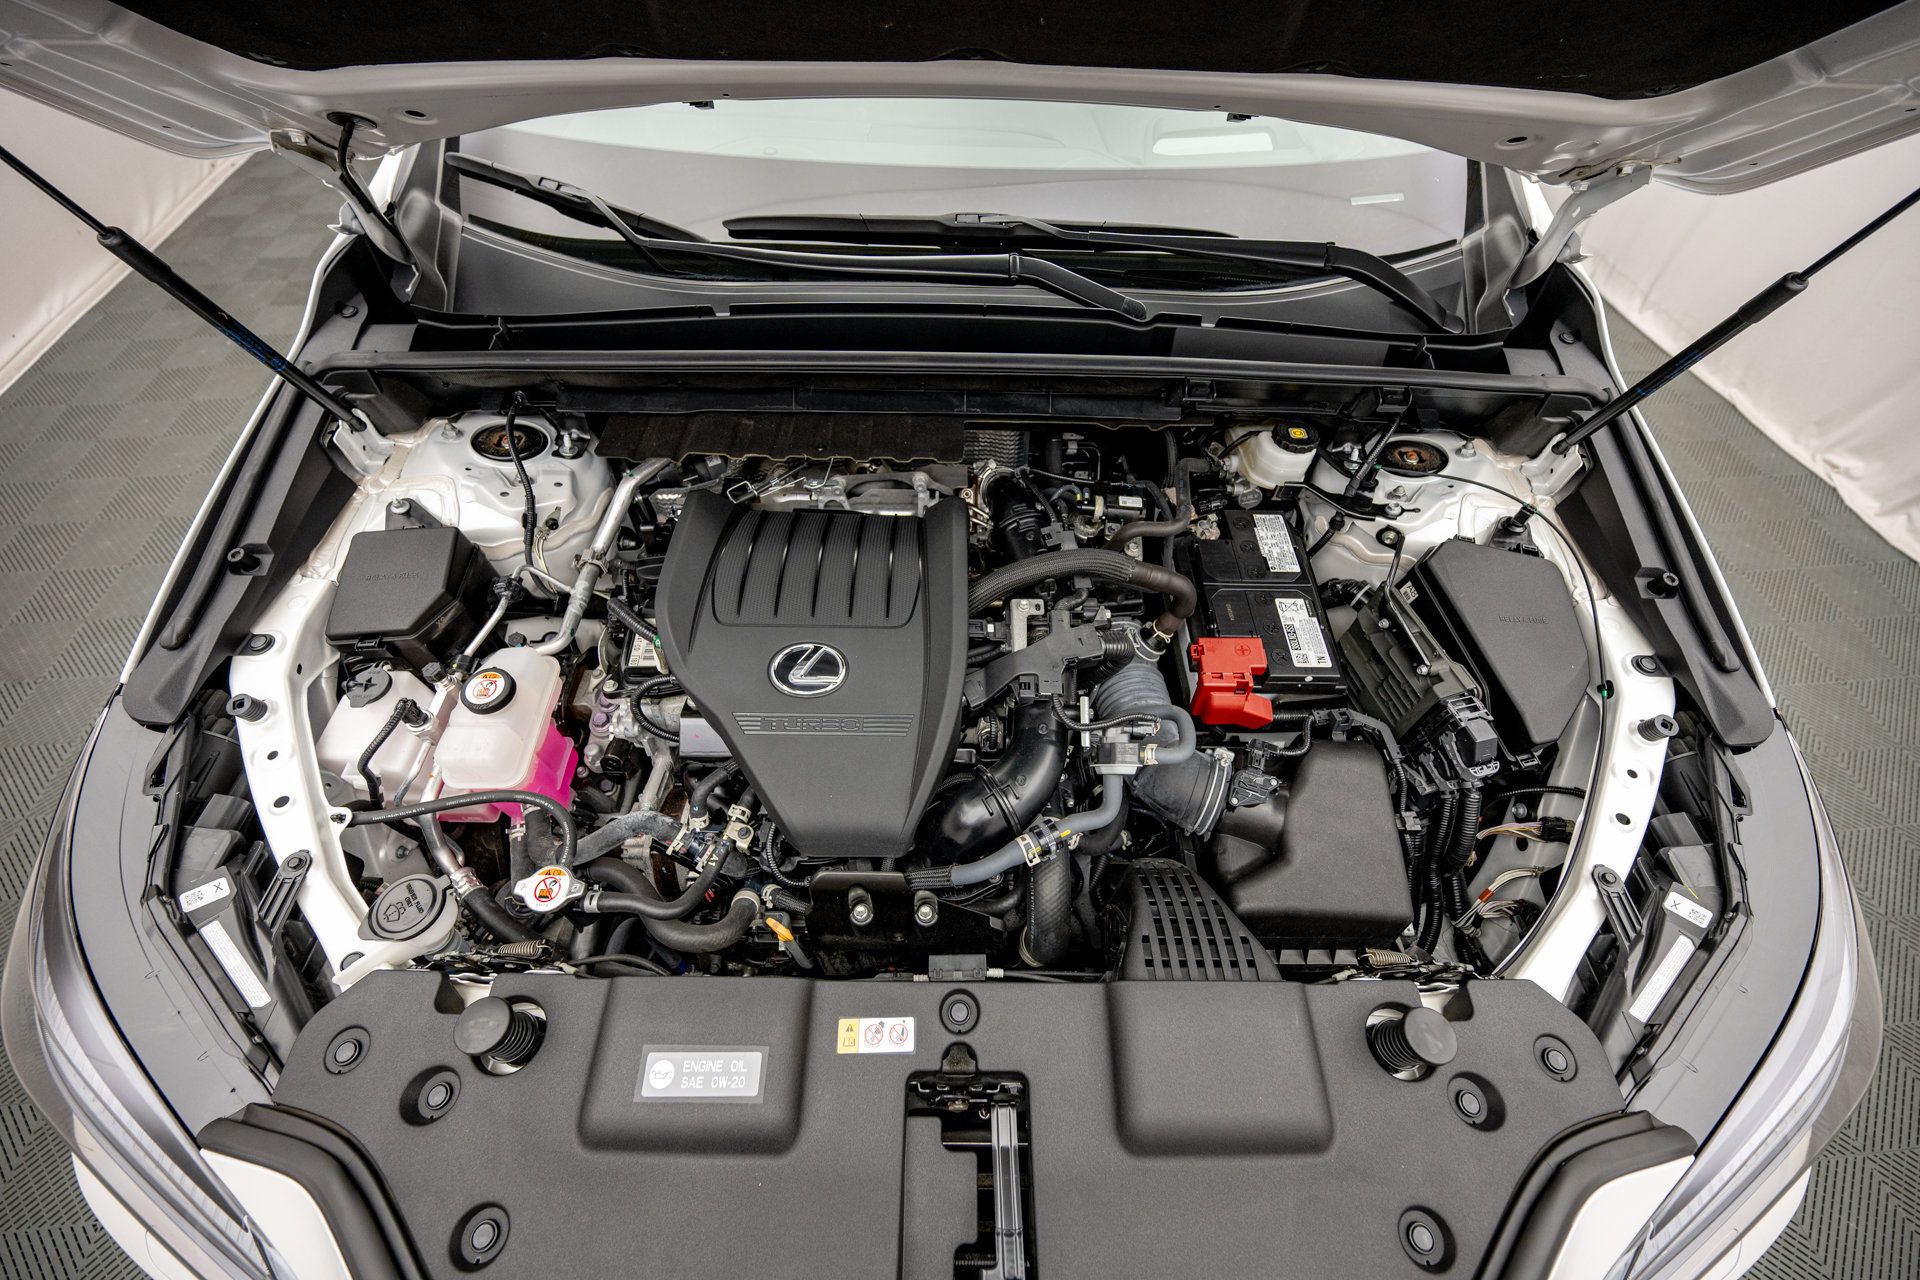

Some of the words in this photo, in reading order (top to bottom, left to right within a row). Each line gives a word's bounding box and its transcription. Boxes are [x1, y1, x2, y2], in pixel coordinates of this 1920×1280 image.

[764, 717, 860, 731] TURBO
[683, 1060, 723, 1072] ENGINE
[730, 1060, 748, 1072] OIL
[681, 1076, 704, 1088] SAE
[711, 1076, 746, 1088] 0W-20
